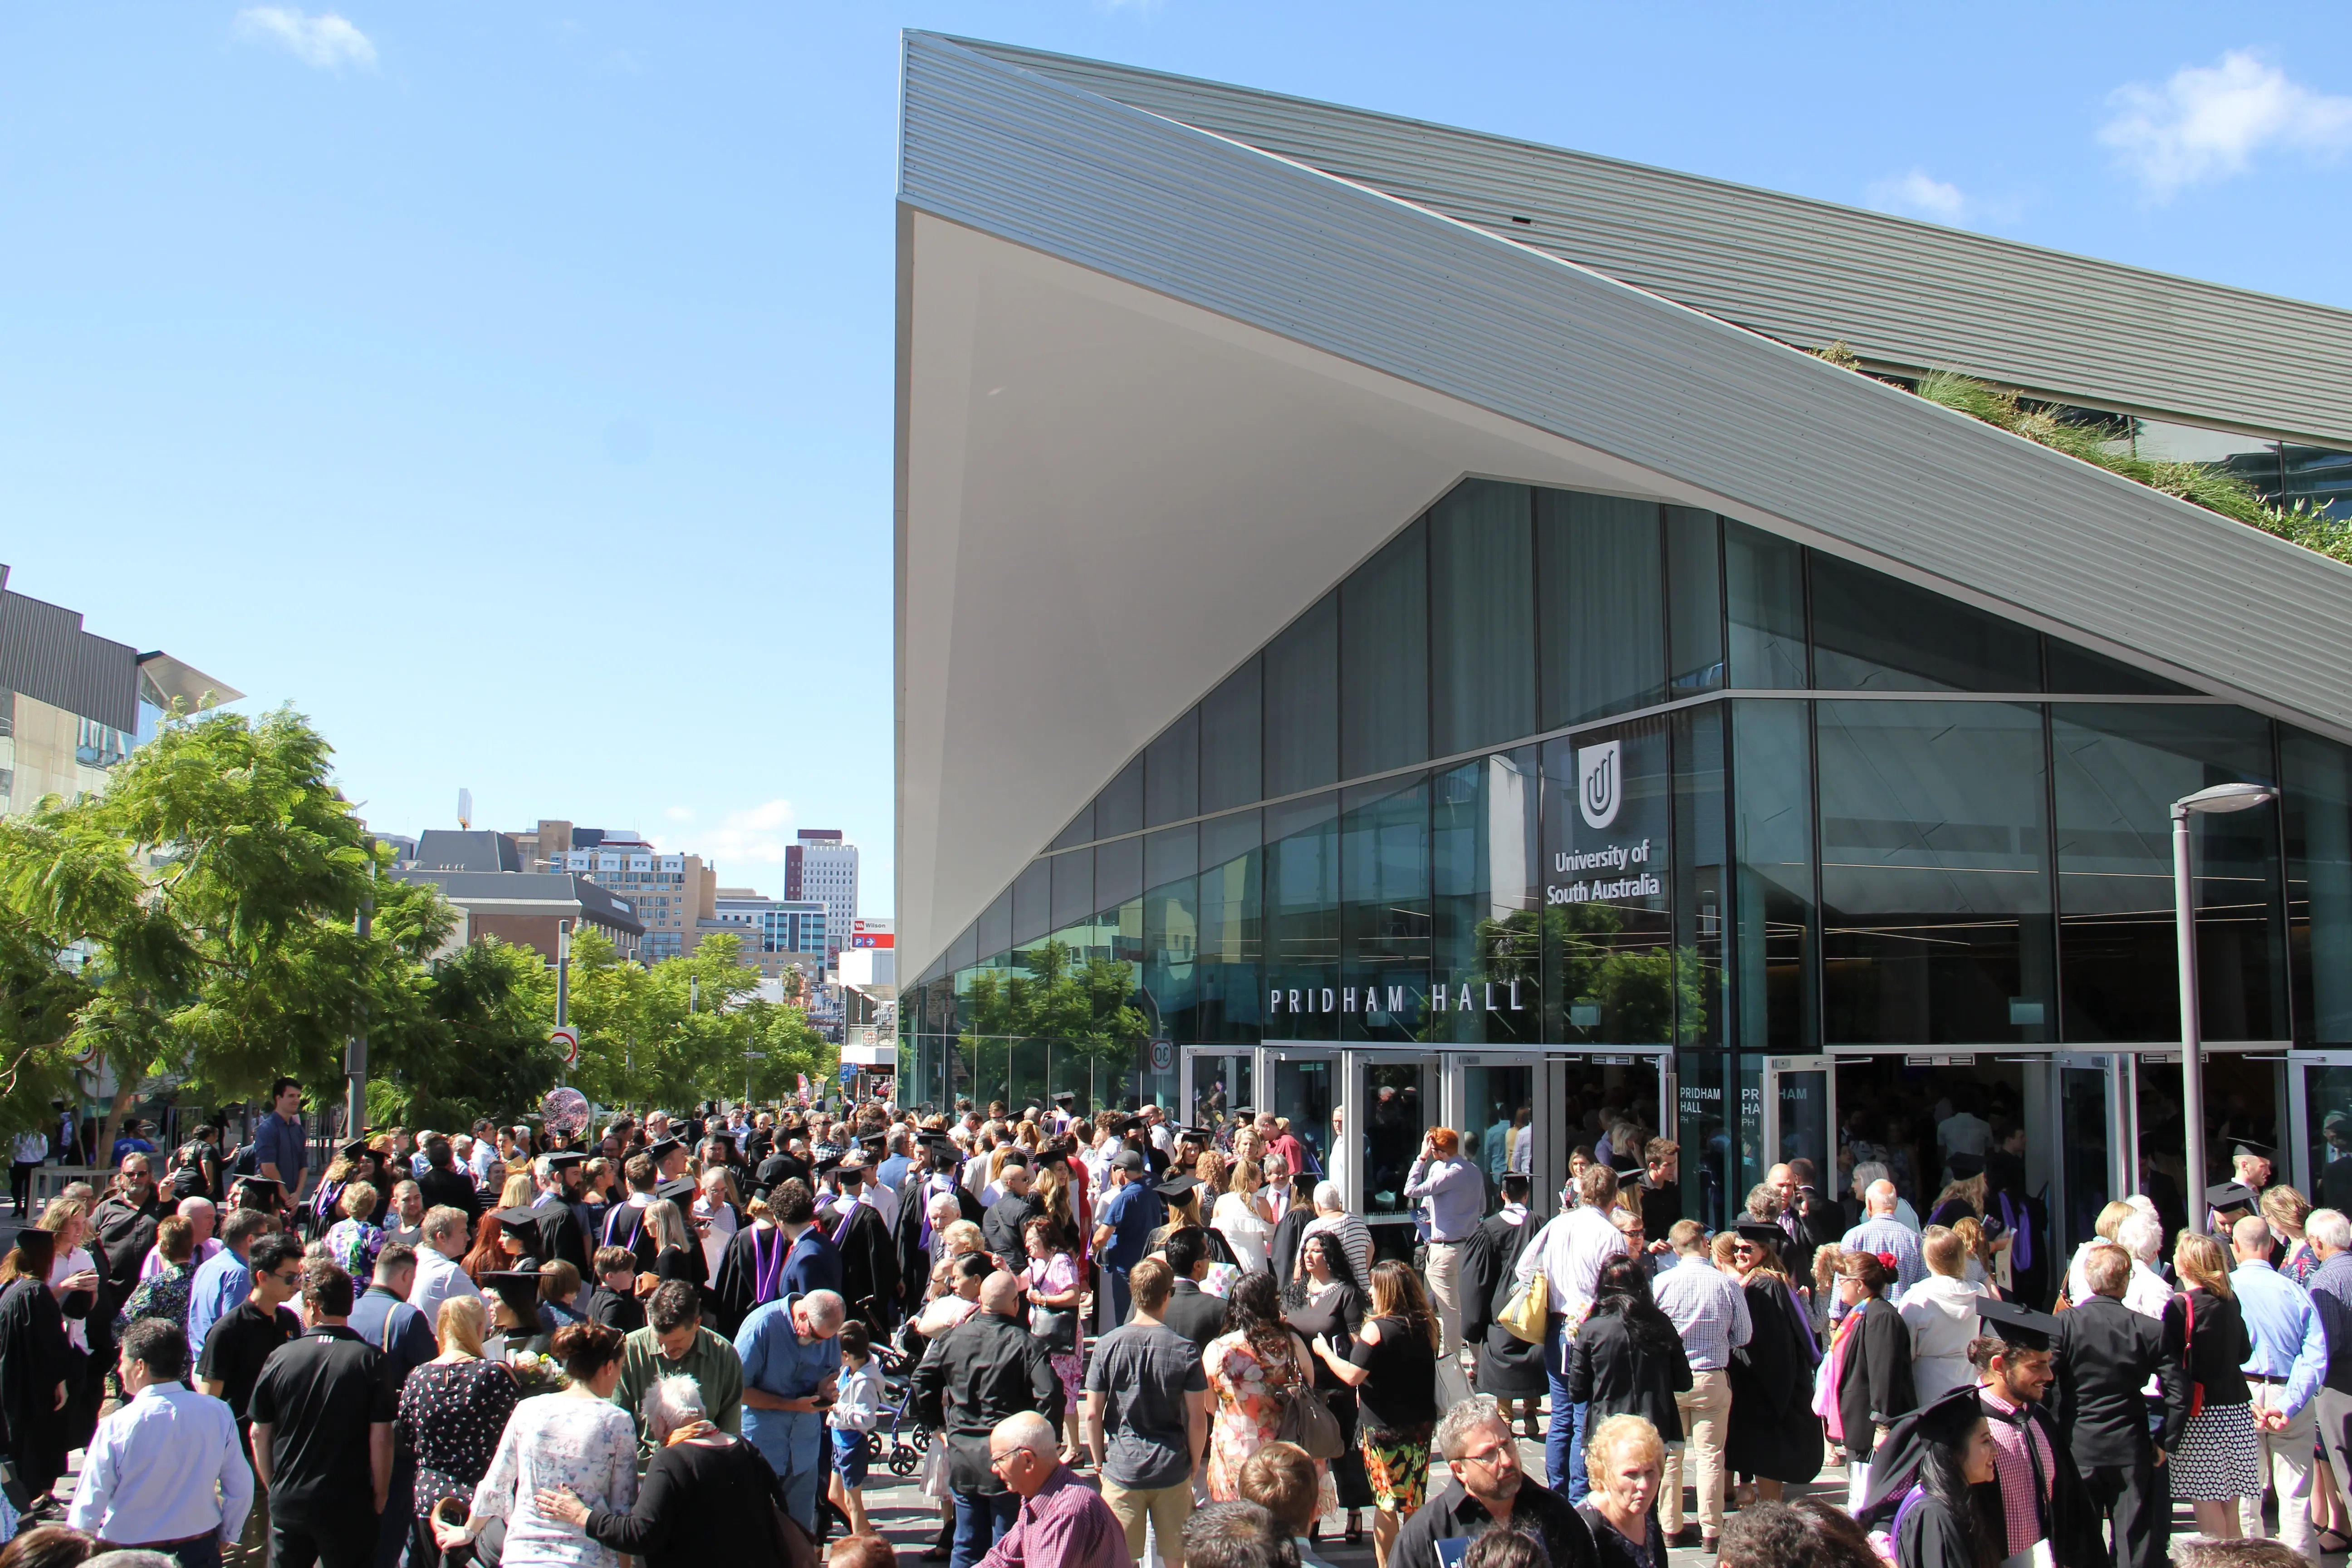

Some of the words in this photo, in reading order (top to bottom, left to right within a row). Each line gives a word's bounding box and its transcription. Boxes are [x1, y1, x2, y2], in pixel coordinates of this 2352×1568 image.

[1555, 845, 1629, 872] University
[1632, 839, 1650, 862] of
[1547, 881, 1589, 905] South
[1591, 873, 1660, 900] Australia
[1271, 985, 1404, 1013] PRIDHAM
[1432, 981, 1524, 1011] HALL
[1680, 1087, 1720, 1100] PRIDHAM
[1681, 1101, 1701, 1113] HALL
